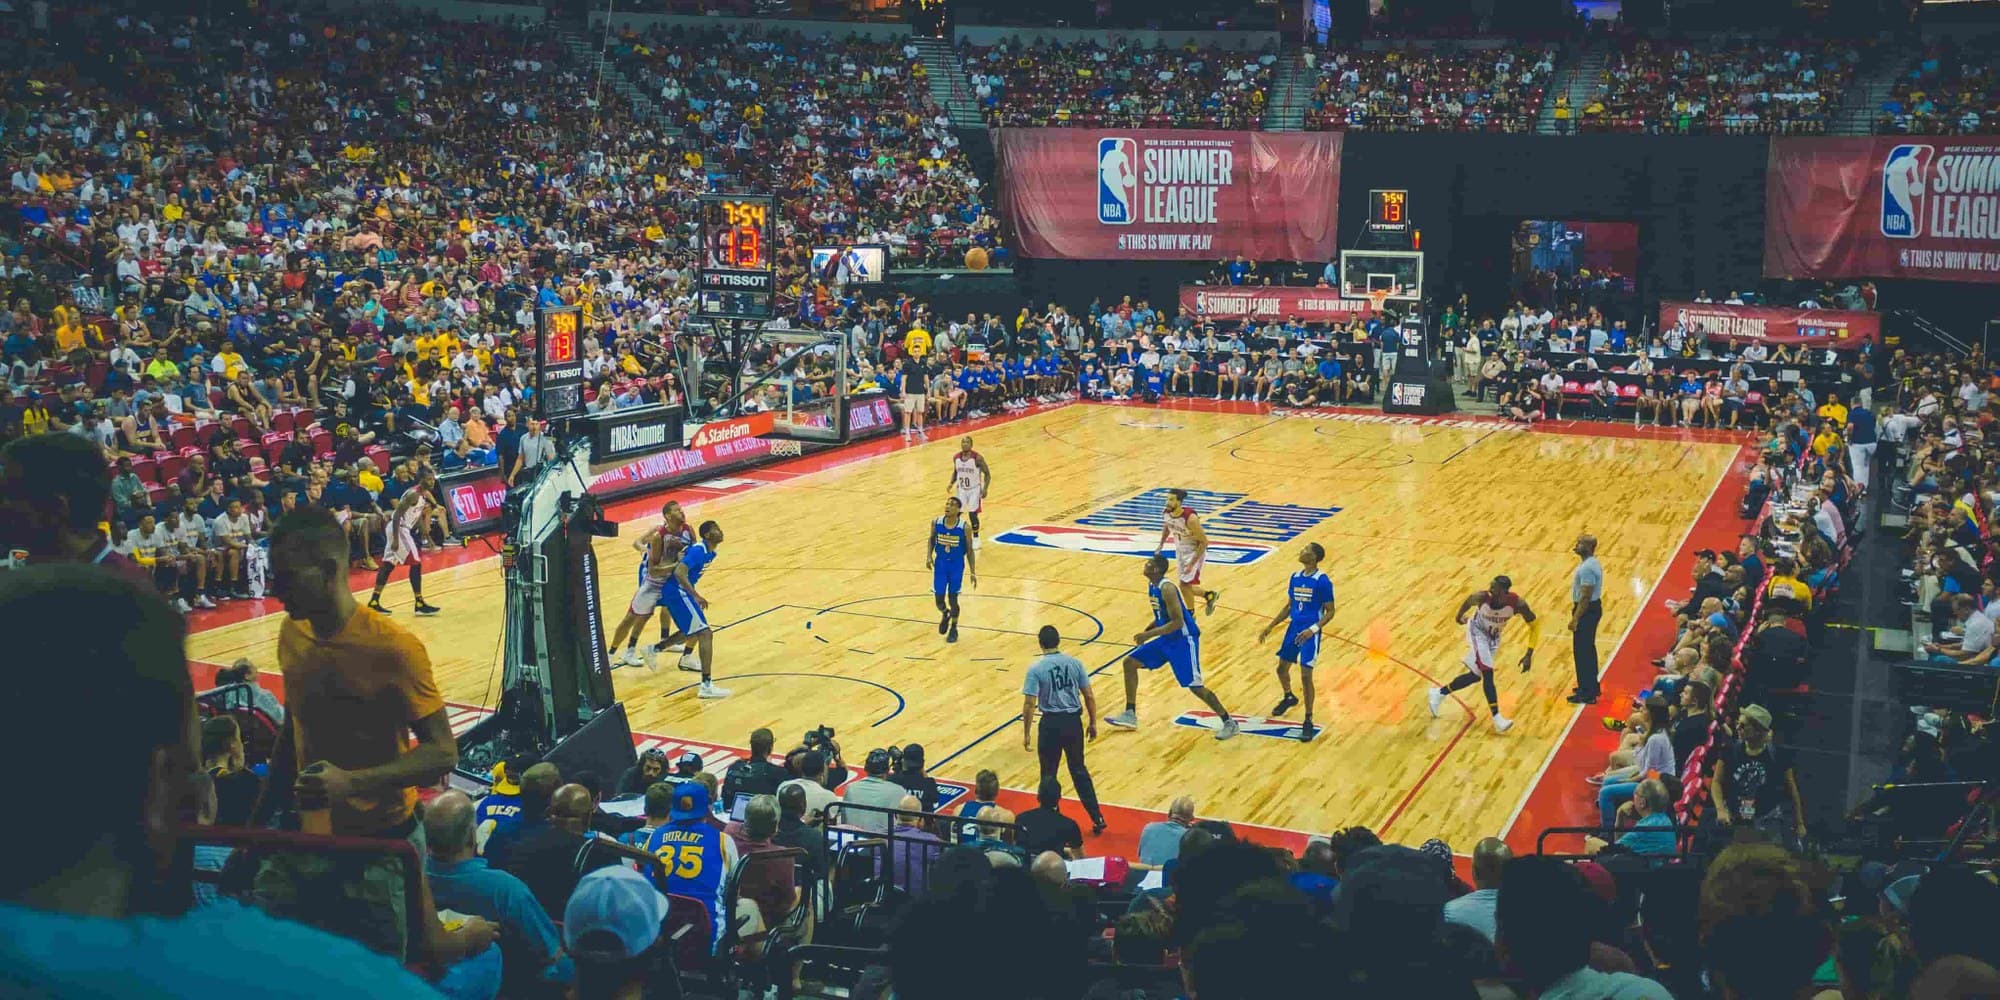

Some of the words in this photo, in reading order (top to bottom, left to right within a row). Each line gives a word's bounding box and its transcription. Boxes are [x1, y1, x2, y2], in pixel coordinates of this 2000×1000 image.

[1144, 149, 1232, 184] SUMMER
[1144, 186, 1218, 223] LEAGUE
[1382, 193, 1403, 203] 7:54
[722, 203, 765, 226] 7:54
[1103, 203, 1121, 217] NBA
[1384, 204, 1400, 221] 13
[1886, 214, 1906, 230] NBA
[727, 226, 759, 268] 13
[1127, 234, 1147, 249] THIS
[1148, 234, 1157, 249] IS
[1159, 234, 1177, 250] WHY
[1178, 234, 1191, 250] WE
[1192, 234, 1212, 250] PLAY
[1911, 249, 1932, 268] THIS
[1932, 250, 1944, 268] IS
[1944, 251, 1967, 269] WHY
[1967, 252, 1983, 270] WE
[720, 275, 768, 287] TISSOT
[1207, 297, 1247, 314] SUMMER
[1248, 297, 1281, 315] LEAGUE
[1731, 317, 1767, 337] LEAGUE
[556, 335, 570, 359] 13
[556, 367, 583, 378] TISSOT
[610, 423, 666, 452] #NBASummer
[461, 492, 477, 514] TV
[585, 574, 595, 611] RESORTS
[1048, 664, 1074, 692] 134
[486, 805, 521, 817] WEST
[662, 831, 704, 843] DURANT
[655, 844, 705, 879] 35
